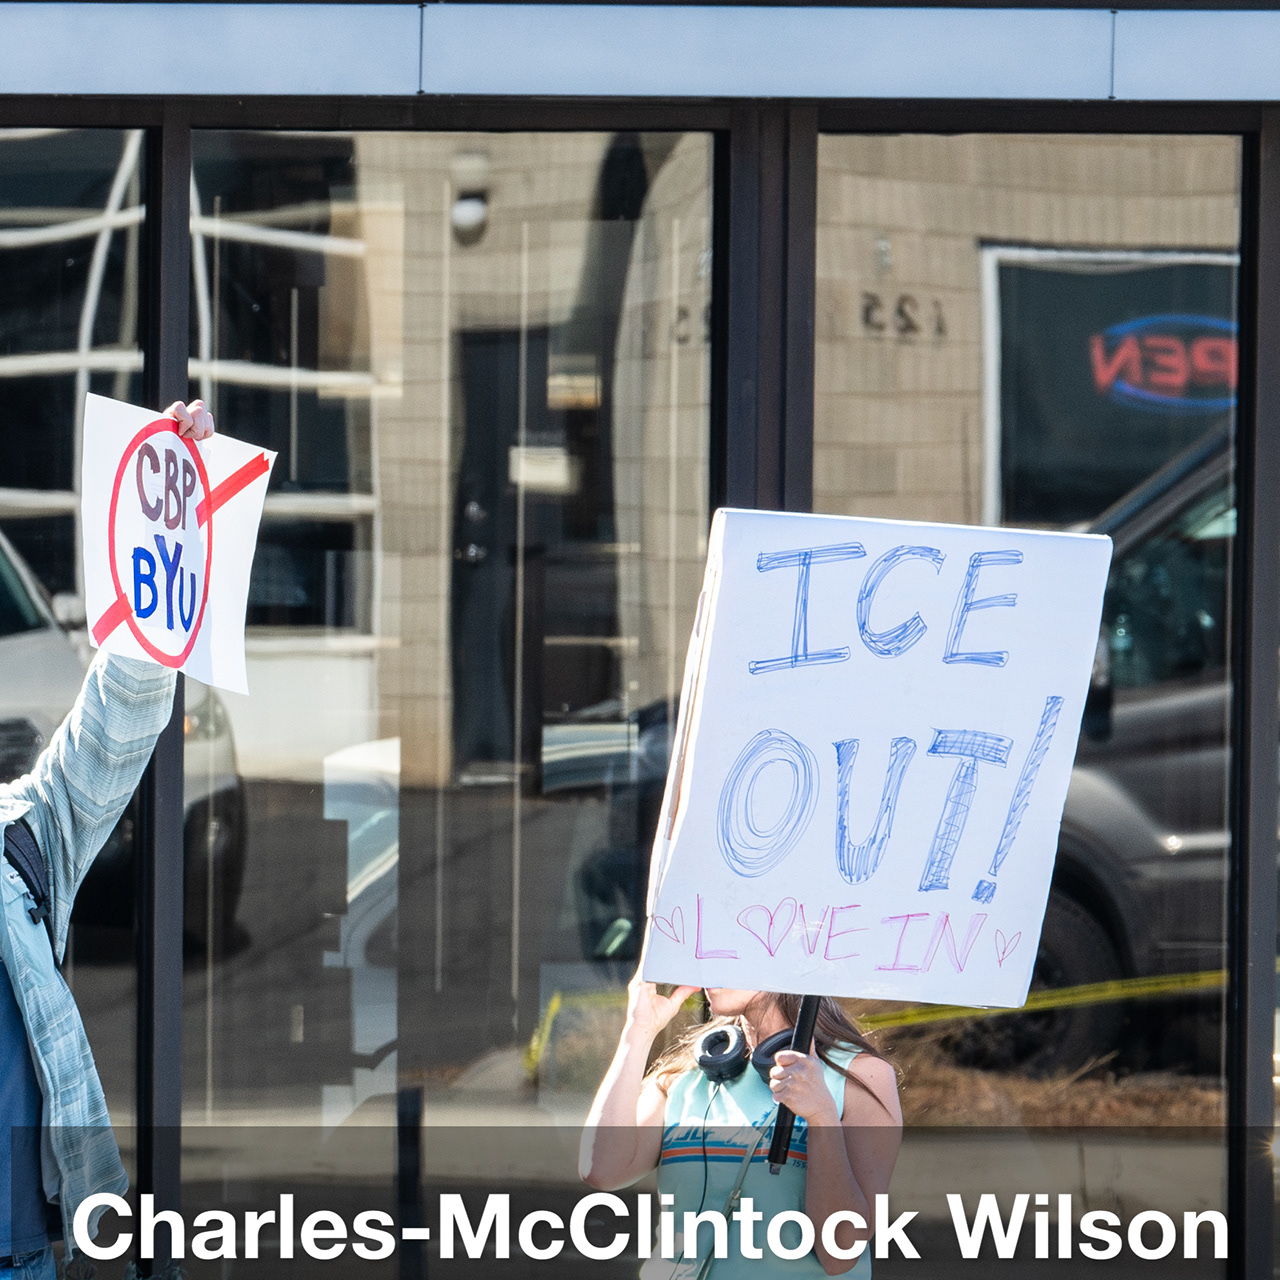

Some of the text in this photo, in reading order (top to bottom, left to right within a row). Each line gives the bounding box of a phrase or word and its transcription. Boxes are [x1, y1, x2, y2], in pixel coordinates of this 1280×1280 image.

[135, 442, 197, 531] CBP
[131, 533, 197, 633] BYU
[748, 542, 1024, 675] ICE
[716, 696, 1065, 904] OUT!
[874, 911, 988, 974] IN
